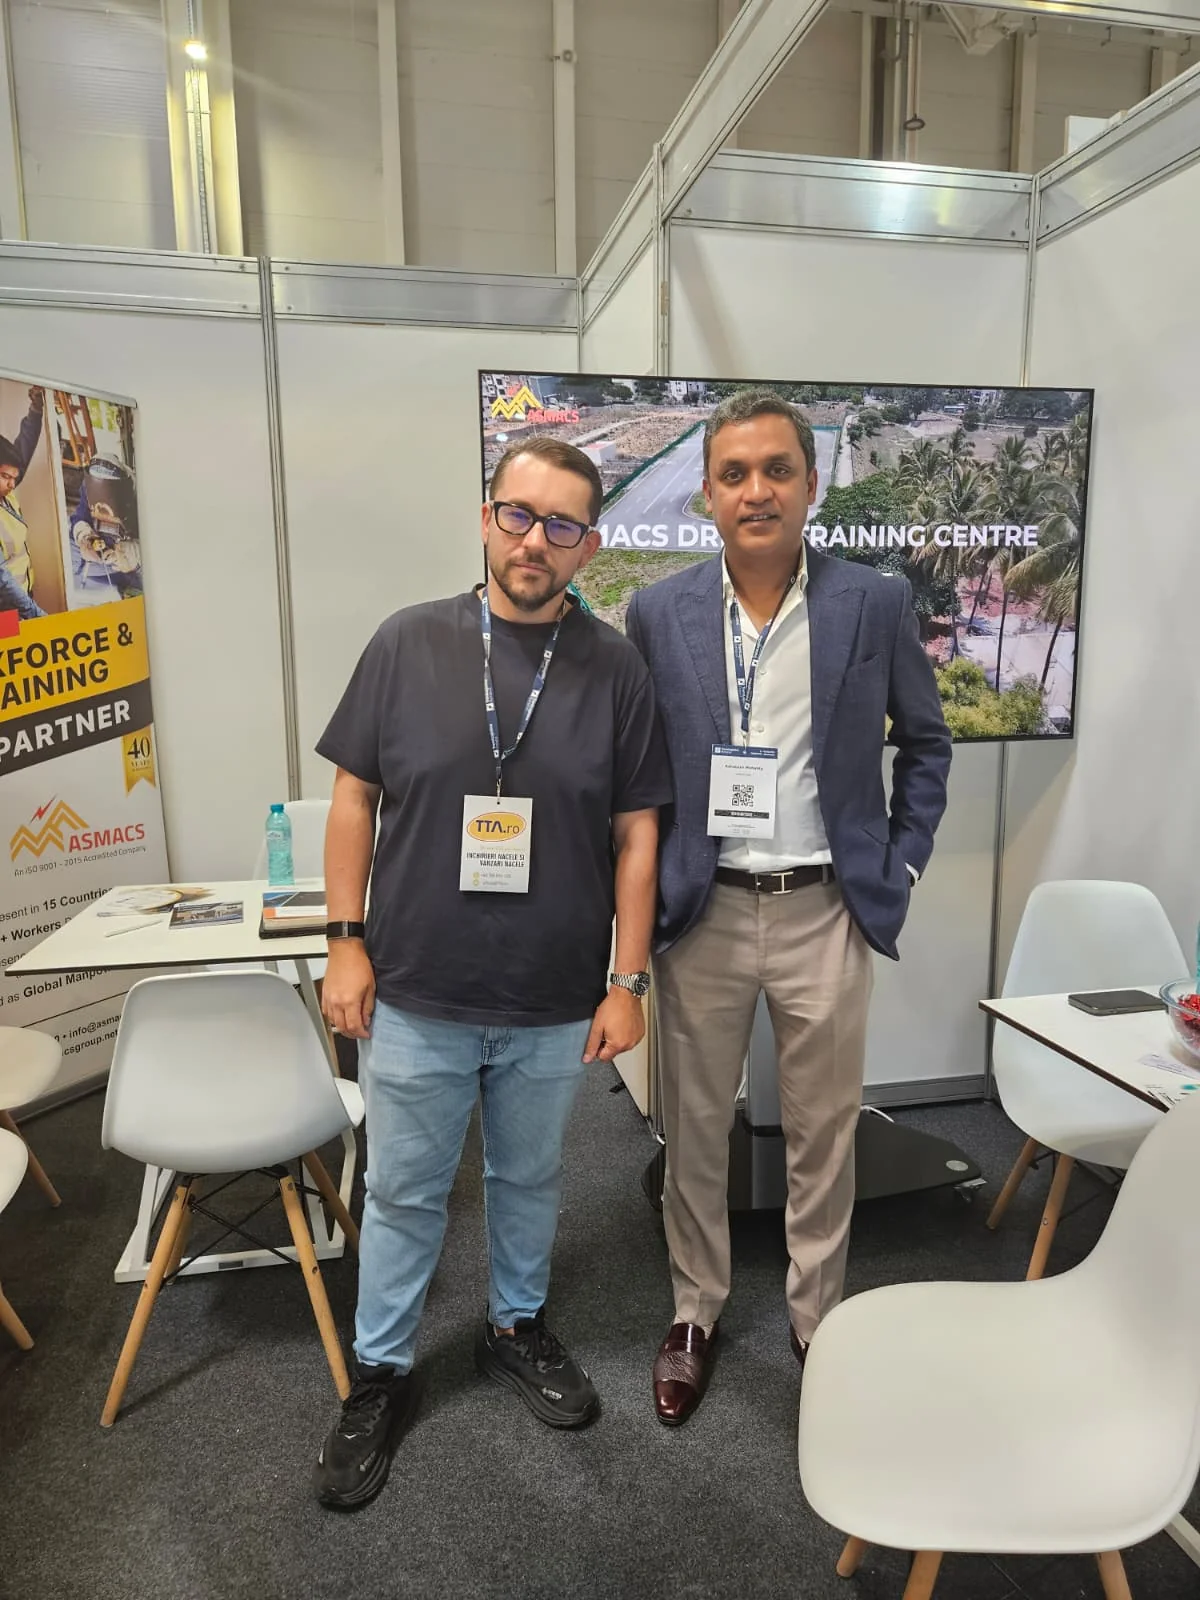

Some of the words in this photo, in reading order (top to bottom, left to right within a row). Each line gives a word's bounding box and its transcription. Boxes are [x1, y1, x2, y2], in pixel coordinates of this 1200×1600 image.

[527, 409, 580, 423] ASMACS
[934, 525, 1039, 547] CENTRE
[117, 622, 133, 647] &
[127, 736, 151, 759] 40
[68, 823, 146, 853] ASMACS
[39, 861, 57, 872] 9001
[30, 904, 40, 914] in
[43, 898, 57, 911] 15
[60, 888, 113, 907] Countrie
[11, 920, 62, 941] Workers
[7, 993, 20, 1004] as
[23, 977, 63, 998] Global
[69, 1014, 122, 1039] info@asma
